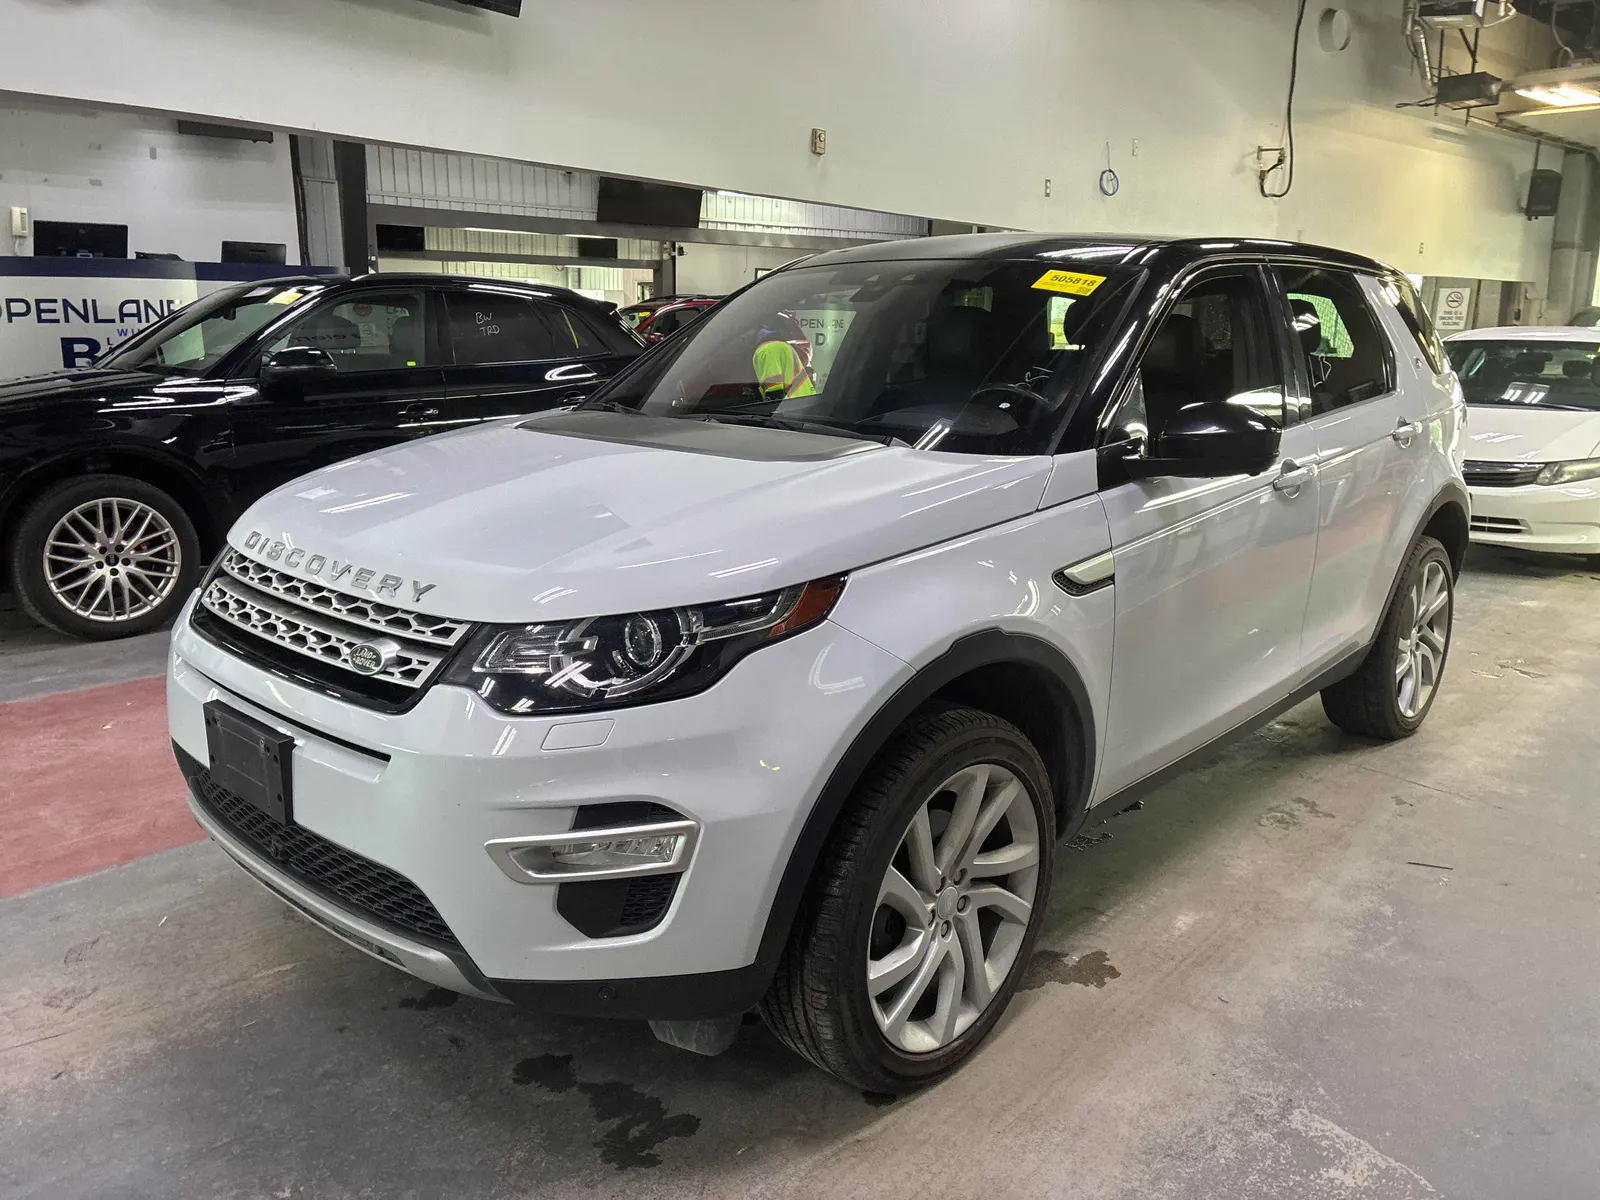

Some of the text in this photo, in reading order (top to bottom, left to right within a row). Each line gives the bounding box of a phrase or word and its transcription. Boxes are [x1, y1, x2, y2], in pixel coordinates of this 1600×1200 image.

[1050, 274, 1097, 287] 505818
[0, 297, 181, 324] PENLAN
[475, 311, 492, 325] BW
[479, 324, 500, 336] TRD
[244, 530, 437, 602] DISCOVERY
